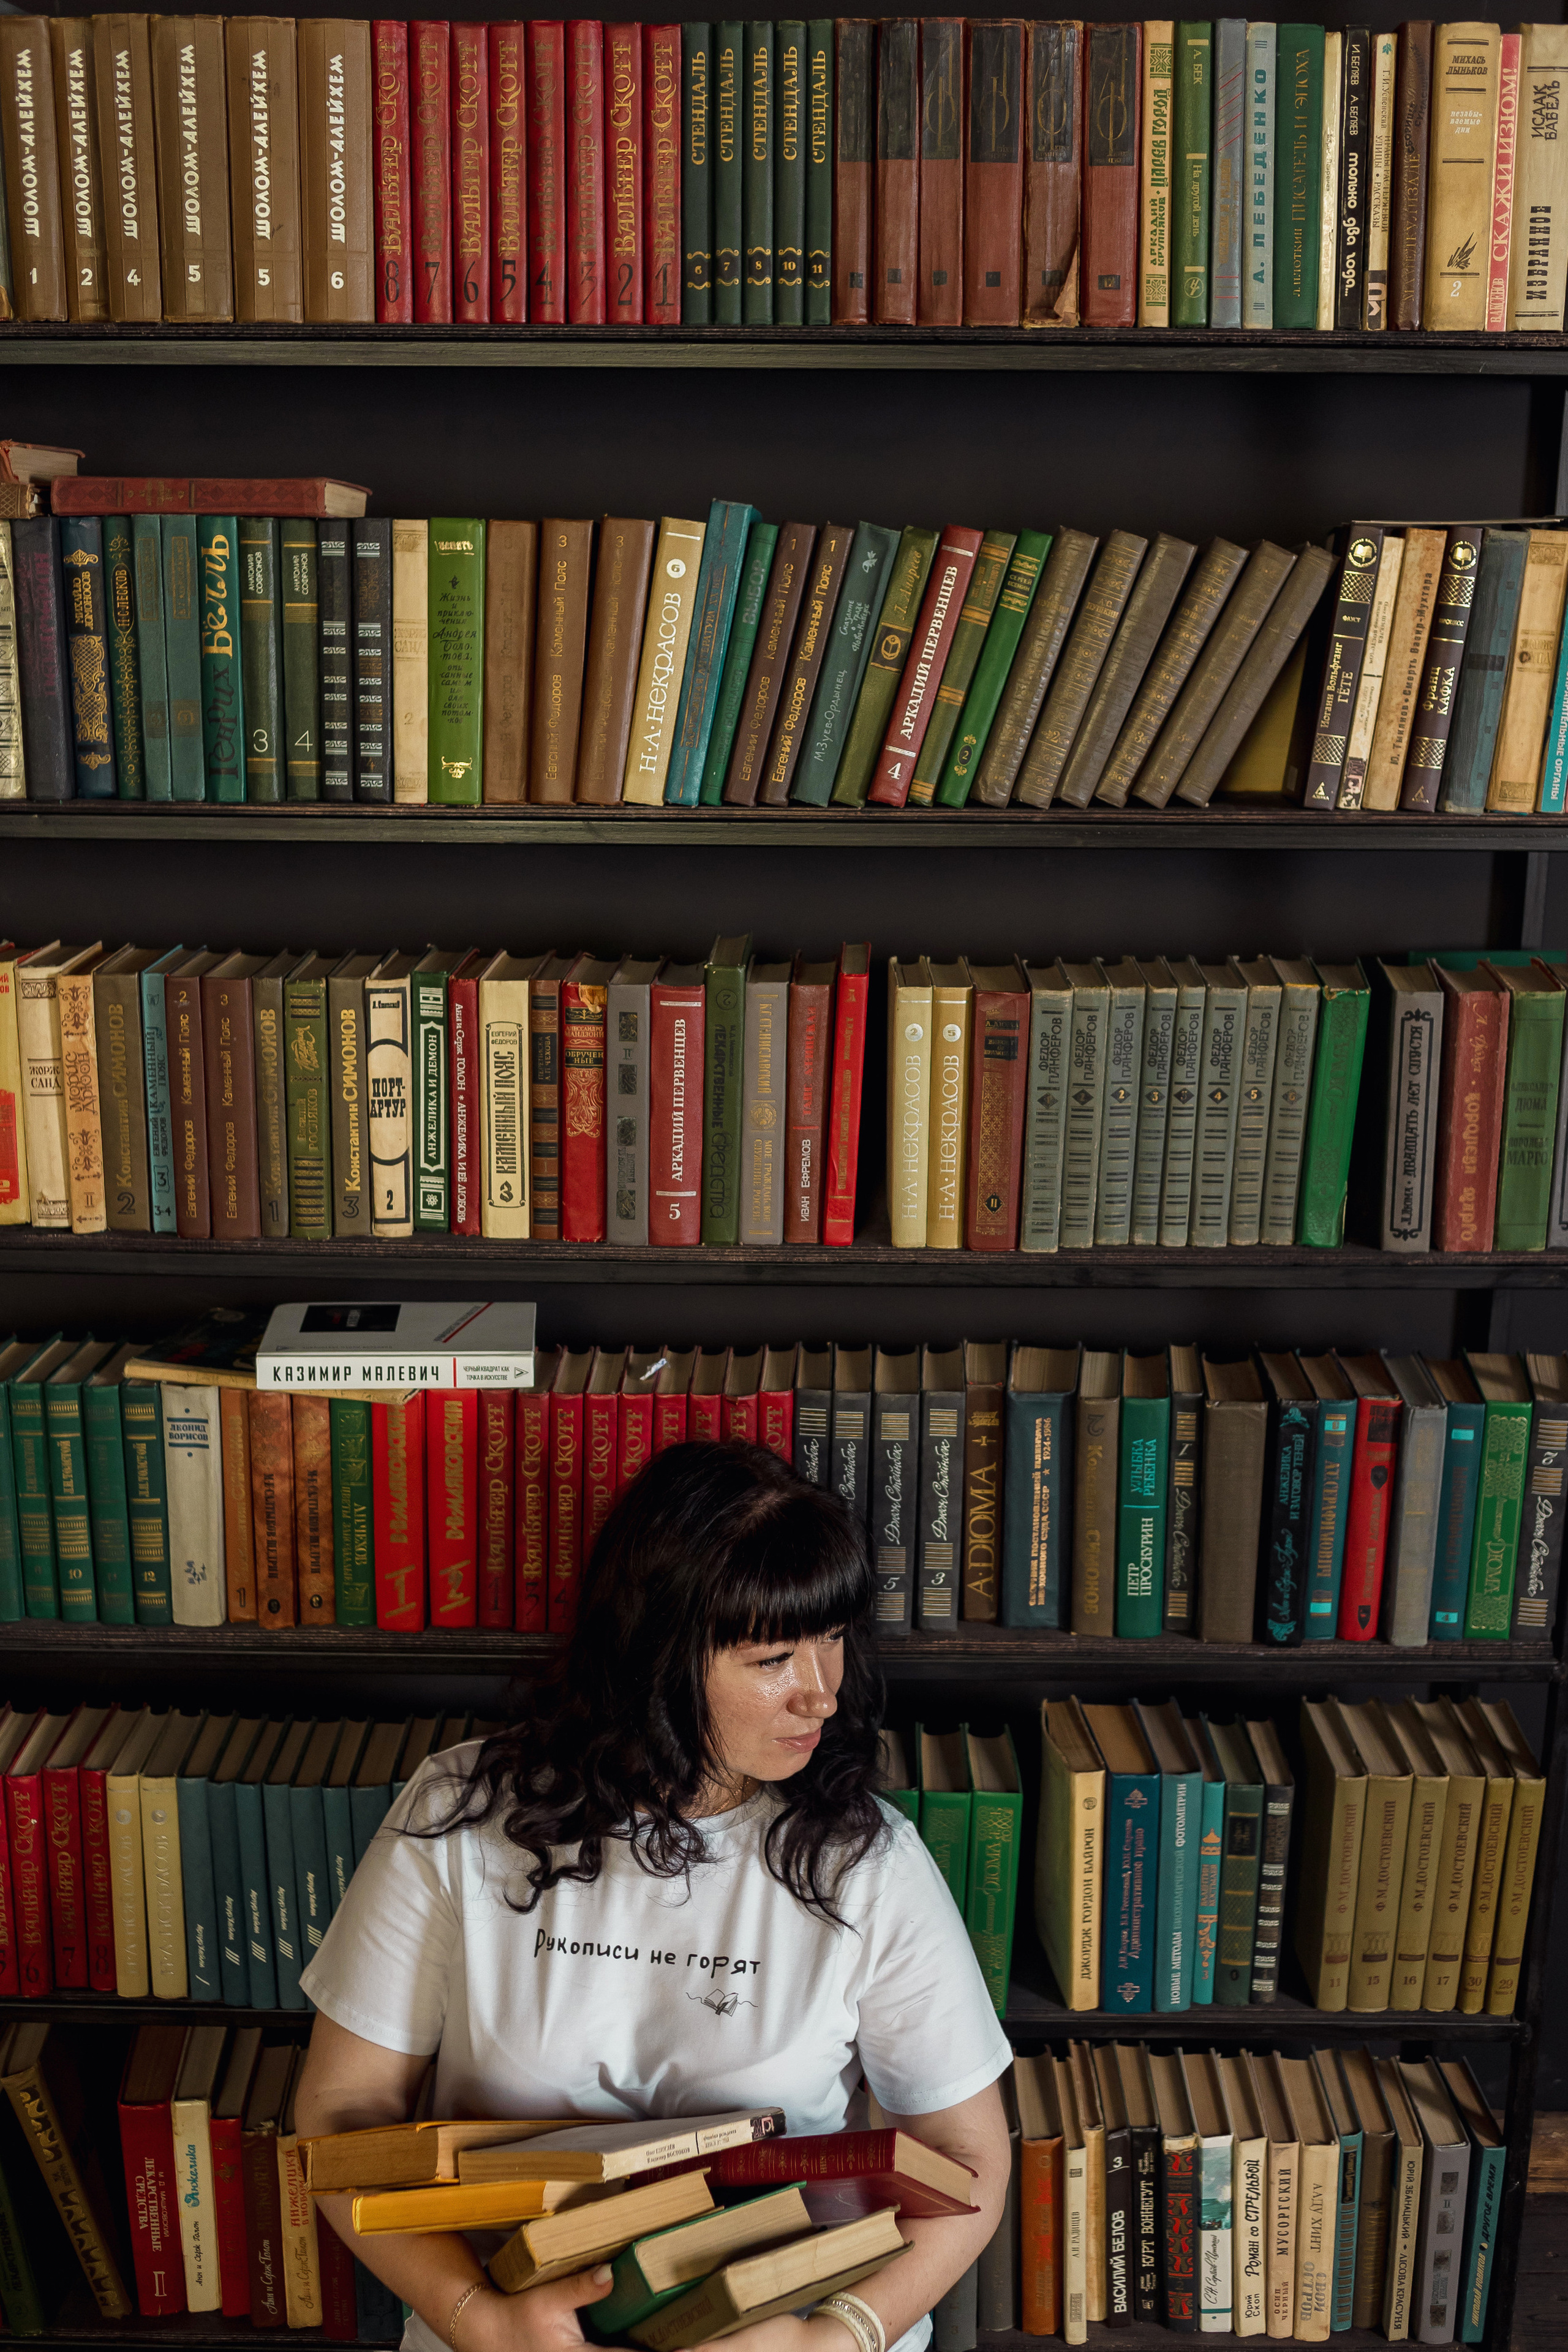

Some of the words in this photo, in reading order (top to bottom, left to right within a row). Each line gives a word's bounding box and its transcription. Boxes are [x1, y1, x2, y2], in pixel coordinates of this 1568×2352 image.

[1452, 55, 1486, 64] МИХАСЬ
[691, 50, 706, 166] СТЕНДАЛЬ
[720, 48, 735, 162] СТЕНДАЛЬ
[753, 47, 767, 160] СТЕНДАЛЬ
[783, 46, 798, 160] СТЕНДАЛЬ
[15, 49, 40, 238] ШОЛОМ-АЛЕЙХЕМ
[68, 49, 91, 238] ШОЛОМ-АЛЕЙХЕМ
[115, 50, 138, 239] ШОЛОМ-АЛЕЙХЕМ
[1253, 69, 1267, 248] ЛЕБЕДЕНКО
[29, 267, 37, 284] 1
[80, 268, 93, 285] 2
[127, 269, 141, 286] 4
[187, 265, 201, 282] 5
[257, 268, 270, 285] 5
[331, 271, 344, 289] 6
[723, 262, 730, 271] 7
[755, 261, 762, 270] 8
[782, 261, 796, 271] 10
[1450, 281, 1461, 297] 2
[900, 665, 930, 740] АРКАДИЙ
[921, 565, 957, 660] ПЕРВЕНЦЕВ
[1423, 666, 1441, 710] Франц
[1438, 666, 1455, 715] КАФКА
[254, 729, 268, 752] 3
[295, 731, 313, 752] 4
[888, 763, 902, 779] 4
[341, 1009, 358, 1102] СИМОНОВ
[428, 1034, 437, 1077] ДЕМОН
[674, 1018, 685, 1107] ПЕРВЕНЦЕВ
[372, 1077, 405, 1097] ПОРТ-
[370, 1099, 405, 1118] АРТУР
[428, 1091, 437, 1159] АНЖЕЛИКА
[344, 1104, 361, 1192] Константин
[671, 1109, 683, 1182] АРКАДИЙ
[801, 1139, 811, 1188] ЕФРЕМОВ
[342, 1196, 359, 1218] 3
[386, 1189, 393, 1210] 2
[669, 1203, 680, 1219] 5
[273, 1366, 352, 1382] КАЗИМИР
[362, 1365, 439, 1381] МАЛЕВИЧ
[463, 1365, 480, 1373] ЧЕРНЫЙ
[1131, 1438, 1143, 1493] УЛЫБКА
[1140, 1518, 1153, 1596] ПРОСКУРИН
[1127, 1564, 1139, 1596] ПЕТР
[1175, 1784, 1186, 1847] ФОТОМЕТРИИ
[1084, 1827, 1095, 1875] БАЙРОН
[1082, 1877, 1093, 1925] ГОРДОН
[534, 1928, 639, 1960] Рукописи
[650, 1949, 676, 1965] не
[687, 1953, 761, 1978] горят
[1080, 1928, 1093, 1980] ДЖОРДЖ
[1172, 1931, 1182, 1964] МЕТОДЫ
[1170, 1967, 1181, 2005] НОВЫЕ
[1367, 1976, 1379, 1986] 15
[1403, 1976, 1417, 1986] 16
[1437, 1976, 1450, 1986] 17
[1140, 2180, 1153, 2234] ВОННЕГУТ
[1276, 2169, 1291, 2255] МУСОРГСКИЙ
[1111, 2210, 1124, 2252] БЕЛОВ
[1142, 2240, 1155, 2267] КУРТ
[1114, 2255, 1126, 2313] ВАСИЛИЙ
